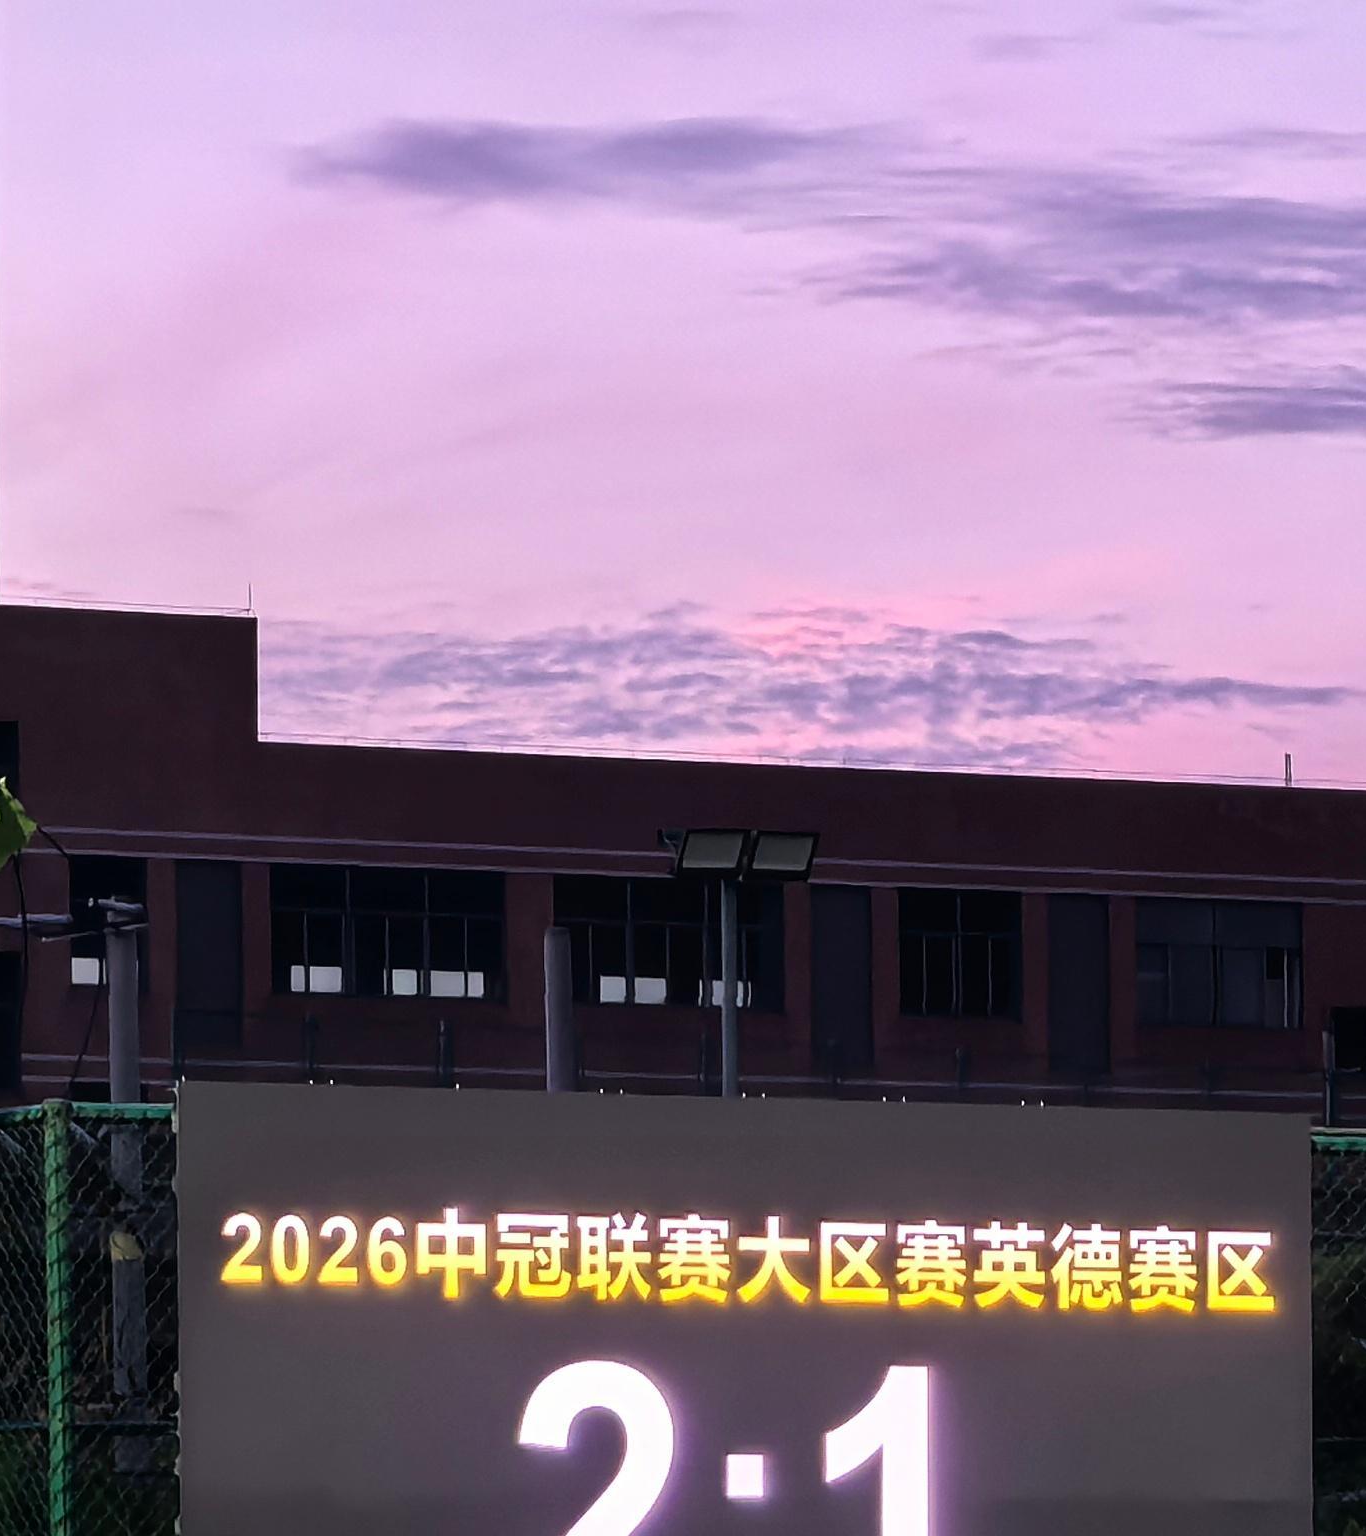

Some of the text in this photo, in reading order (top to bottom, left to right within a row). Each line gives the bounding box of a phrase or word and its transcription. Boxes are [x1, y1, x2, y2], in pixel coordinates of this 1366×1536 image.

[220, 1206, 1276, 1314] 2026中冠联赛大区赛英德赛区
